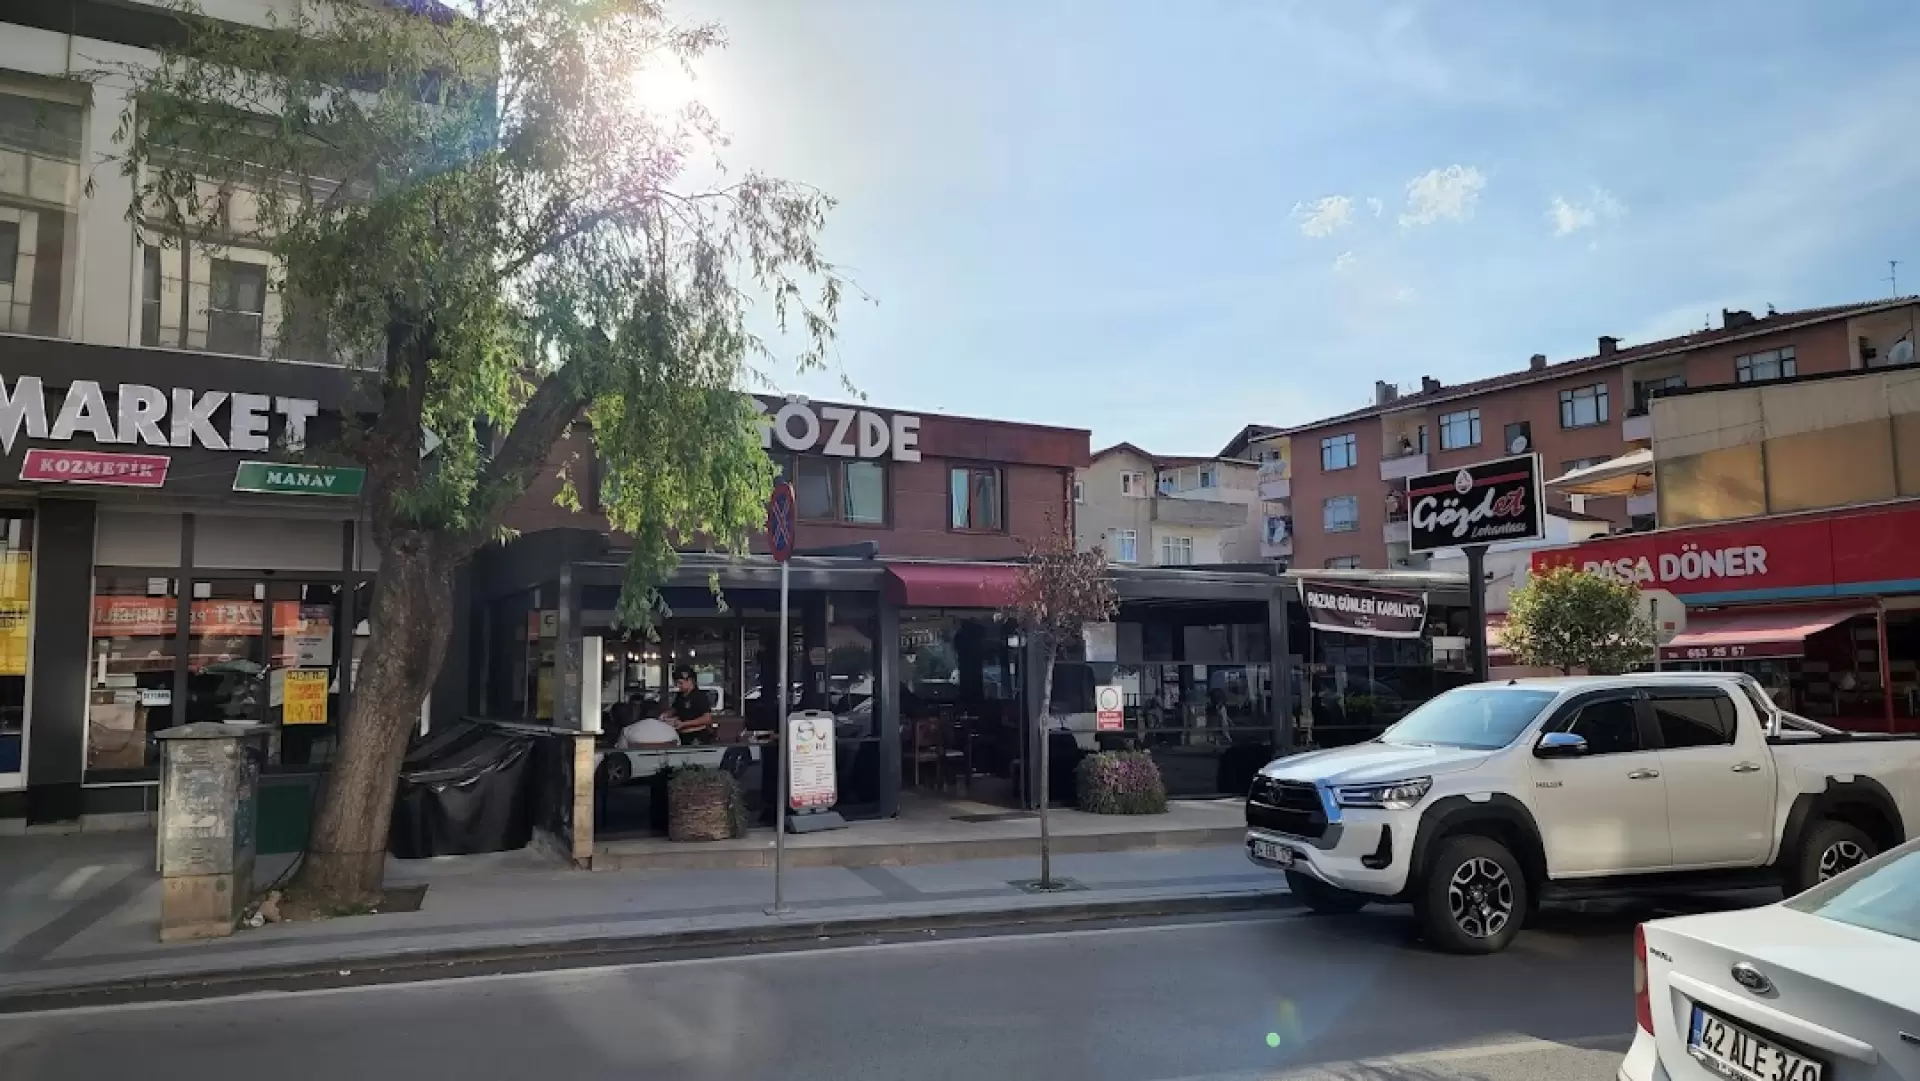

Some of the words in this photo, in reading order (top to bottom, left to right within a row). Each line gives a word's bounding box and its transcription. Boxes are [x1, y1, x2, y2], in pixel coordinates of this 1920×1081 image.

[0, 373, 319, 455] MARKET
[39, 458, 155, 477] KOZMETİK
[266, 470, 336, 488] MANAV
[1659, 543, 1768, 583] DÖNER
[1307, 591, 1337, 610] PAZAR
[1338, 594, 1375, 614] GÜNLERİ
[1702, 1018, 1725, 1056] 42
[1730, 1029, 1768, 1078] ALE
